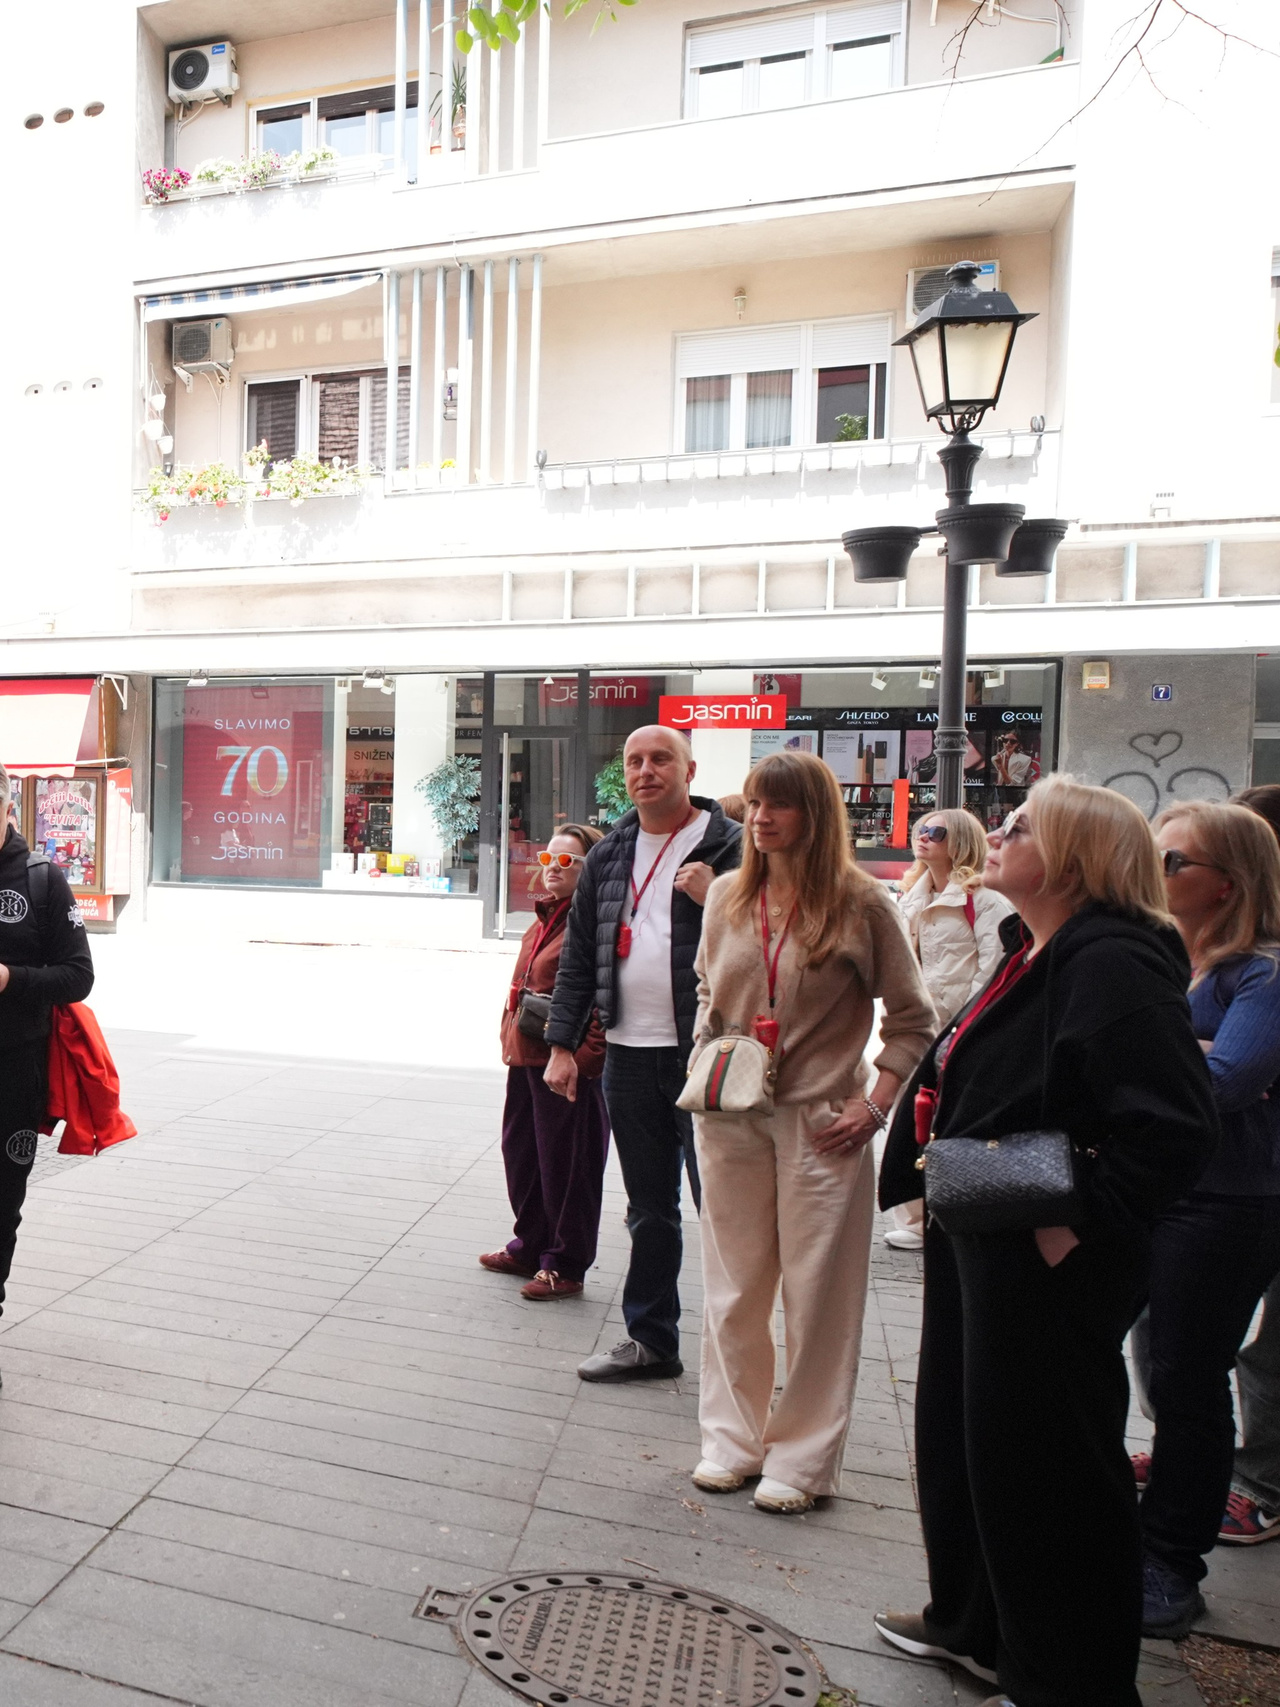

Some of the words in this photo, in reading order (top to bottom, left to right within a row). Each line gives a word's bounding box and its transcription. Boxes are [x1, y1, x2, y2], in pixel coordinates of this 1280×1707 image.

[1158, 687, 1166, 698] 7
[835, 710, 890, 720] SHISEIDO
[214, 718, 291, 730] SLAVIMO
[216, 745, 289, 797] 70
[213, 811, 287, 825] GODINA
